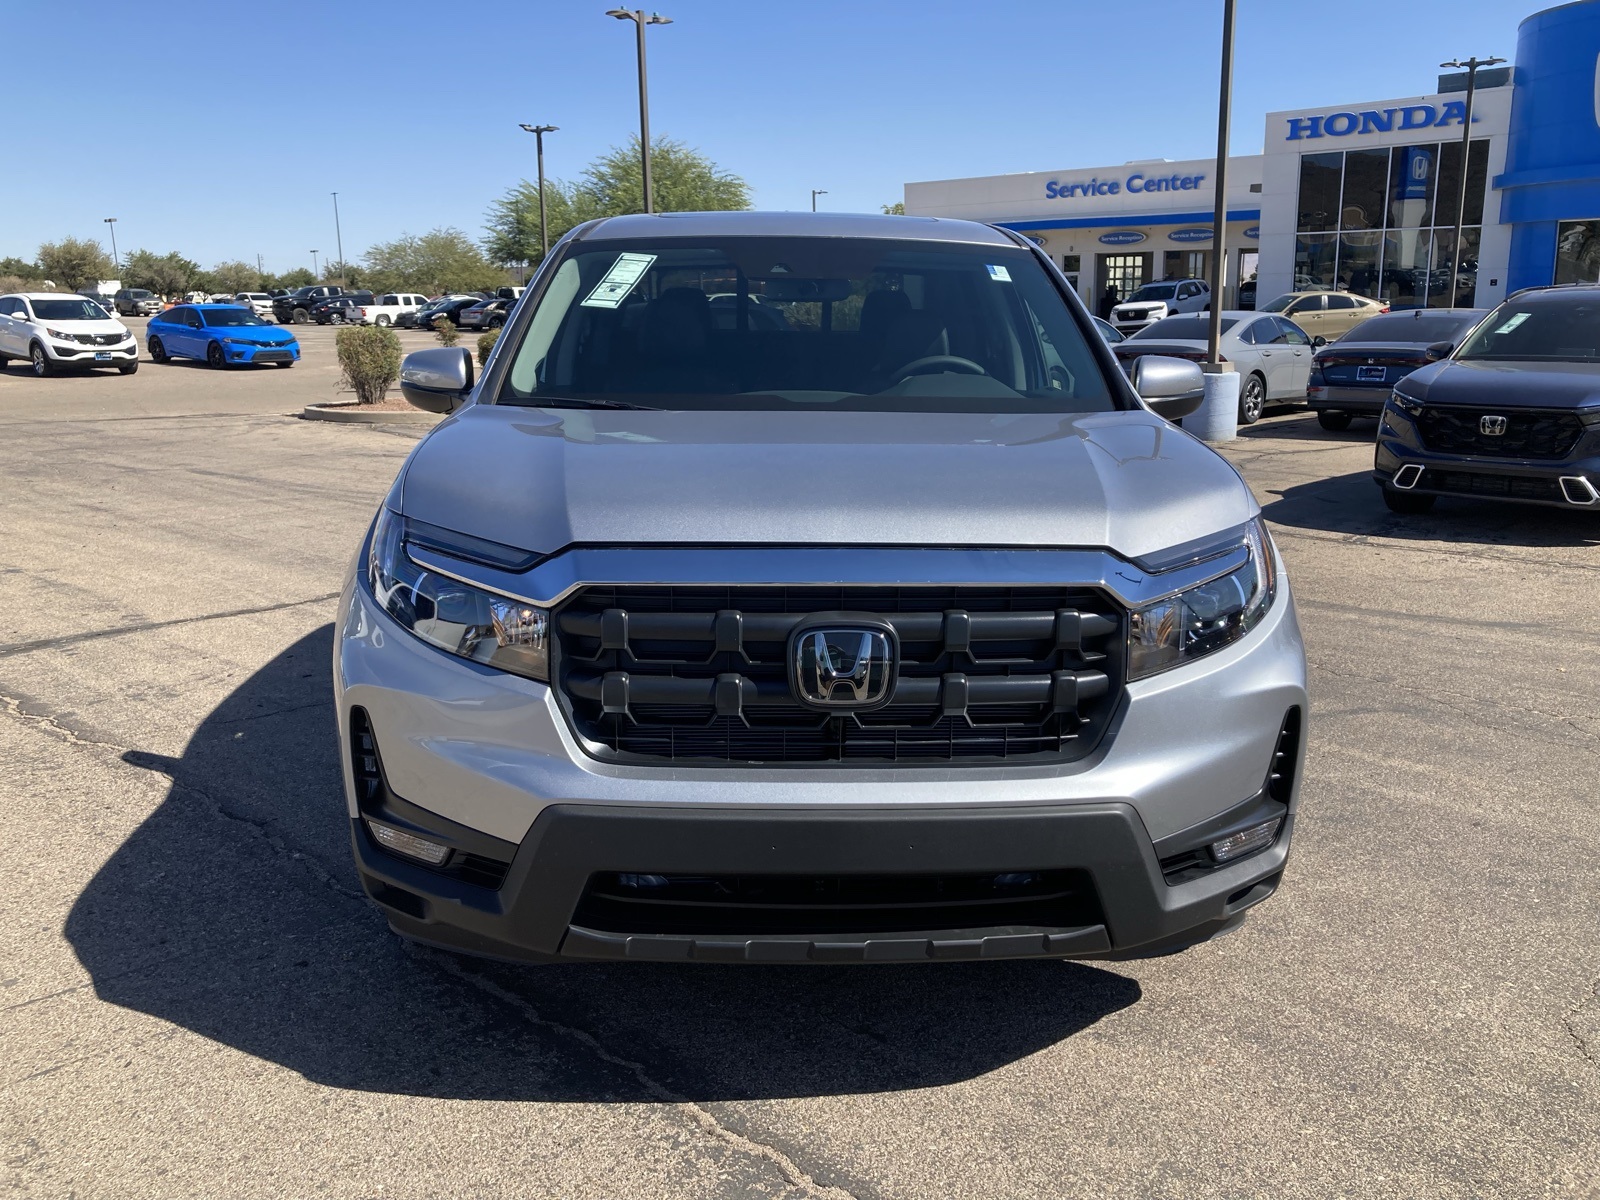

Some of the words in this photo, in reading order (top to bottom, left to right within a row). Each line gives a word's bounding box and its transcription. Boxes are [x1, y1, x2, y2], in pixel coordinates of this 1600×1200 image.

[1286, 101, 1478, 140] HONDA
[1046, 178, 1120, 199] Service
[1126, 174, 1205, 194] Center
